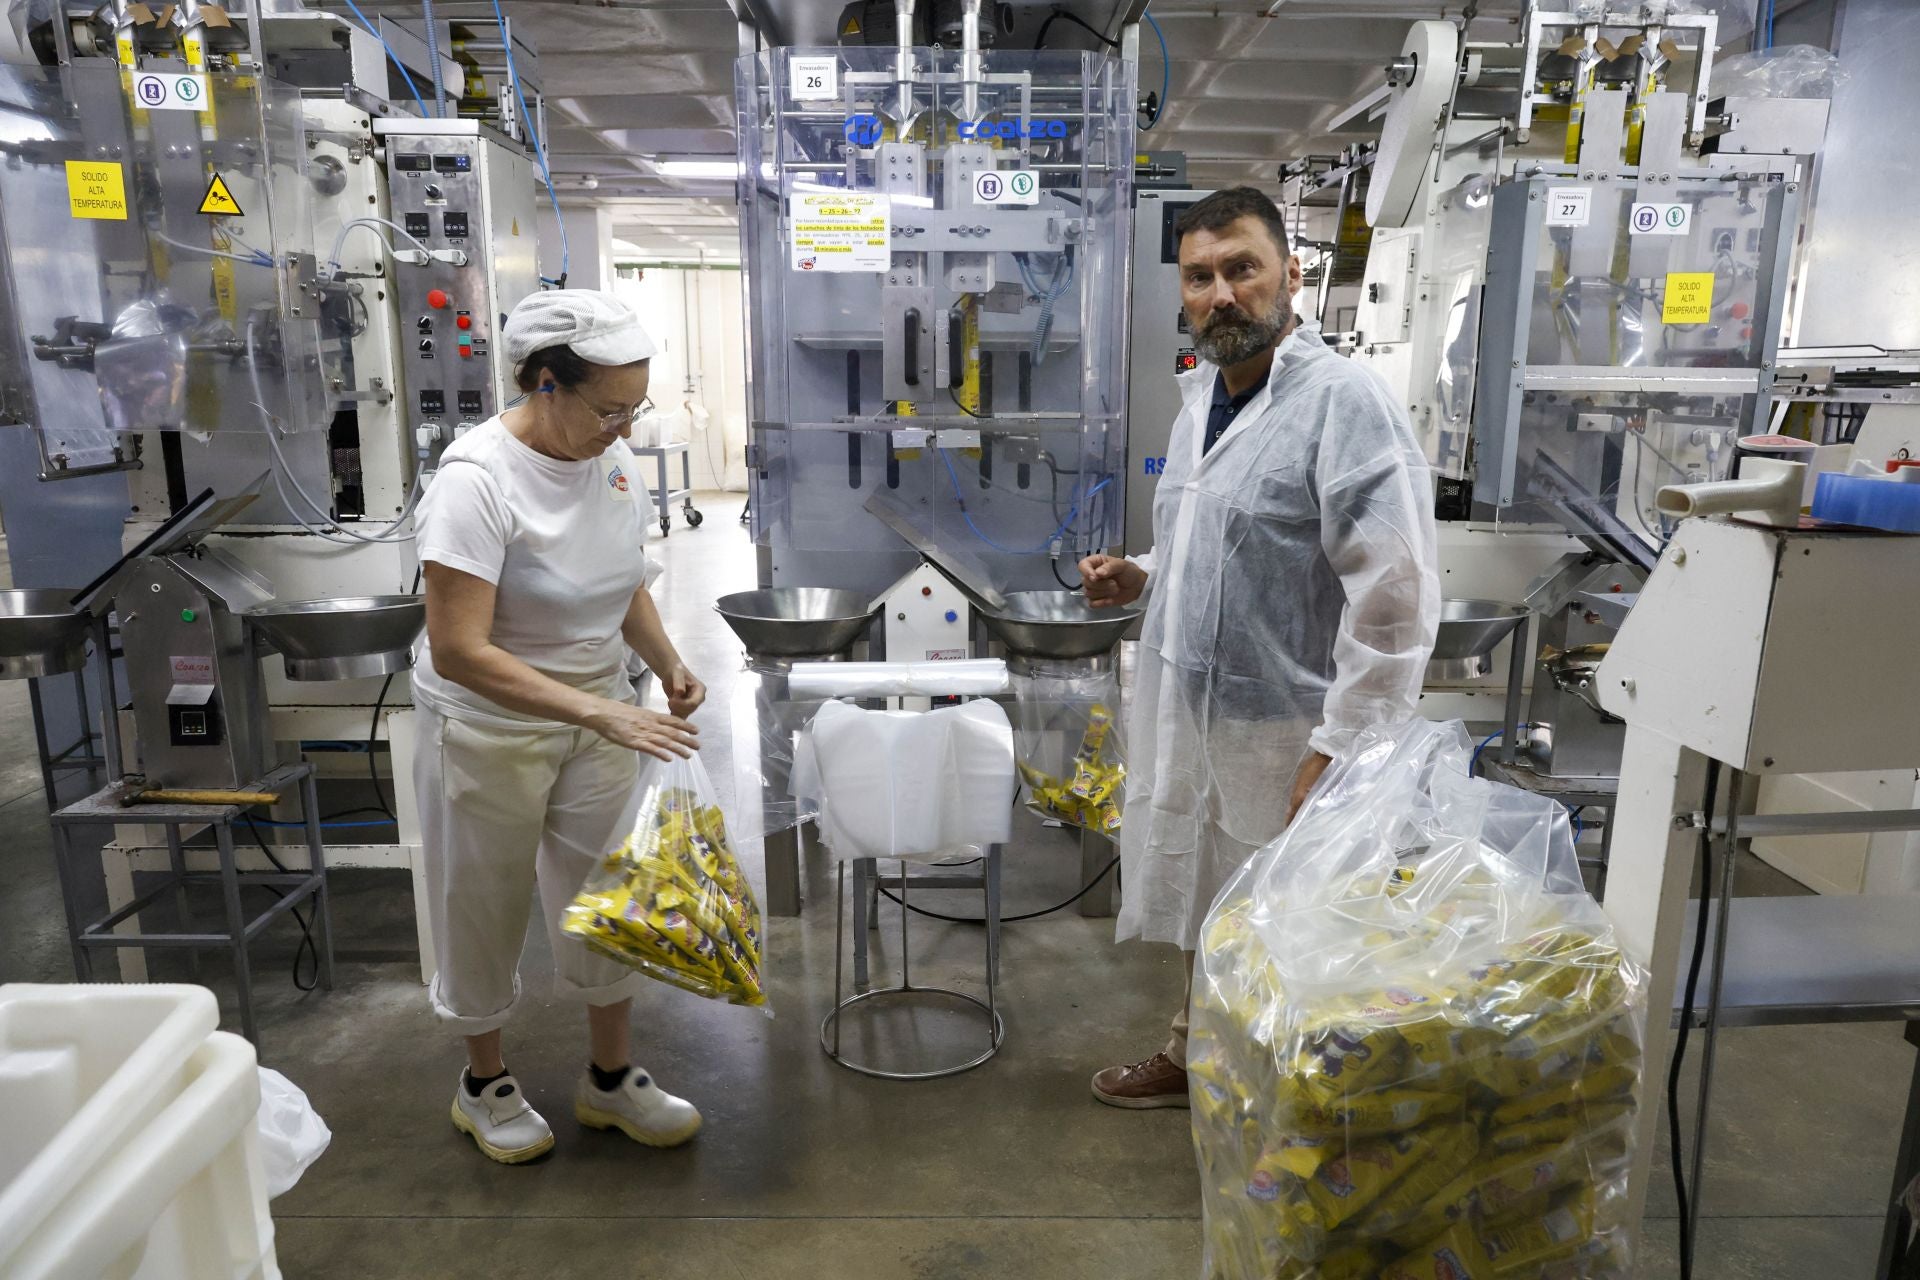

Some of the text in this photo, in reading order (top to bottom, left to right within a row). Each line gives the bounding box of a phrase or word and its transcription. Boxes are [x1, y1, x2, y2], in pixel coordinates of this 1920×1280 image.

[807, 76, 822, 88] 26
[957, 117, 1067, 138] coalza
[89, 186, 105, 195] ALTA
[73, 199, 123, 209] TEMPERATURA
[1562, 205, 1576, 215] 27
[1681, 294, 1695, 303] ALTA
[1665, 306, 1708, 315] TEMPERATURA
